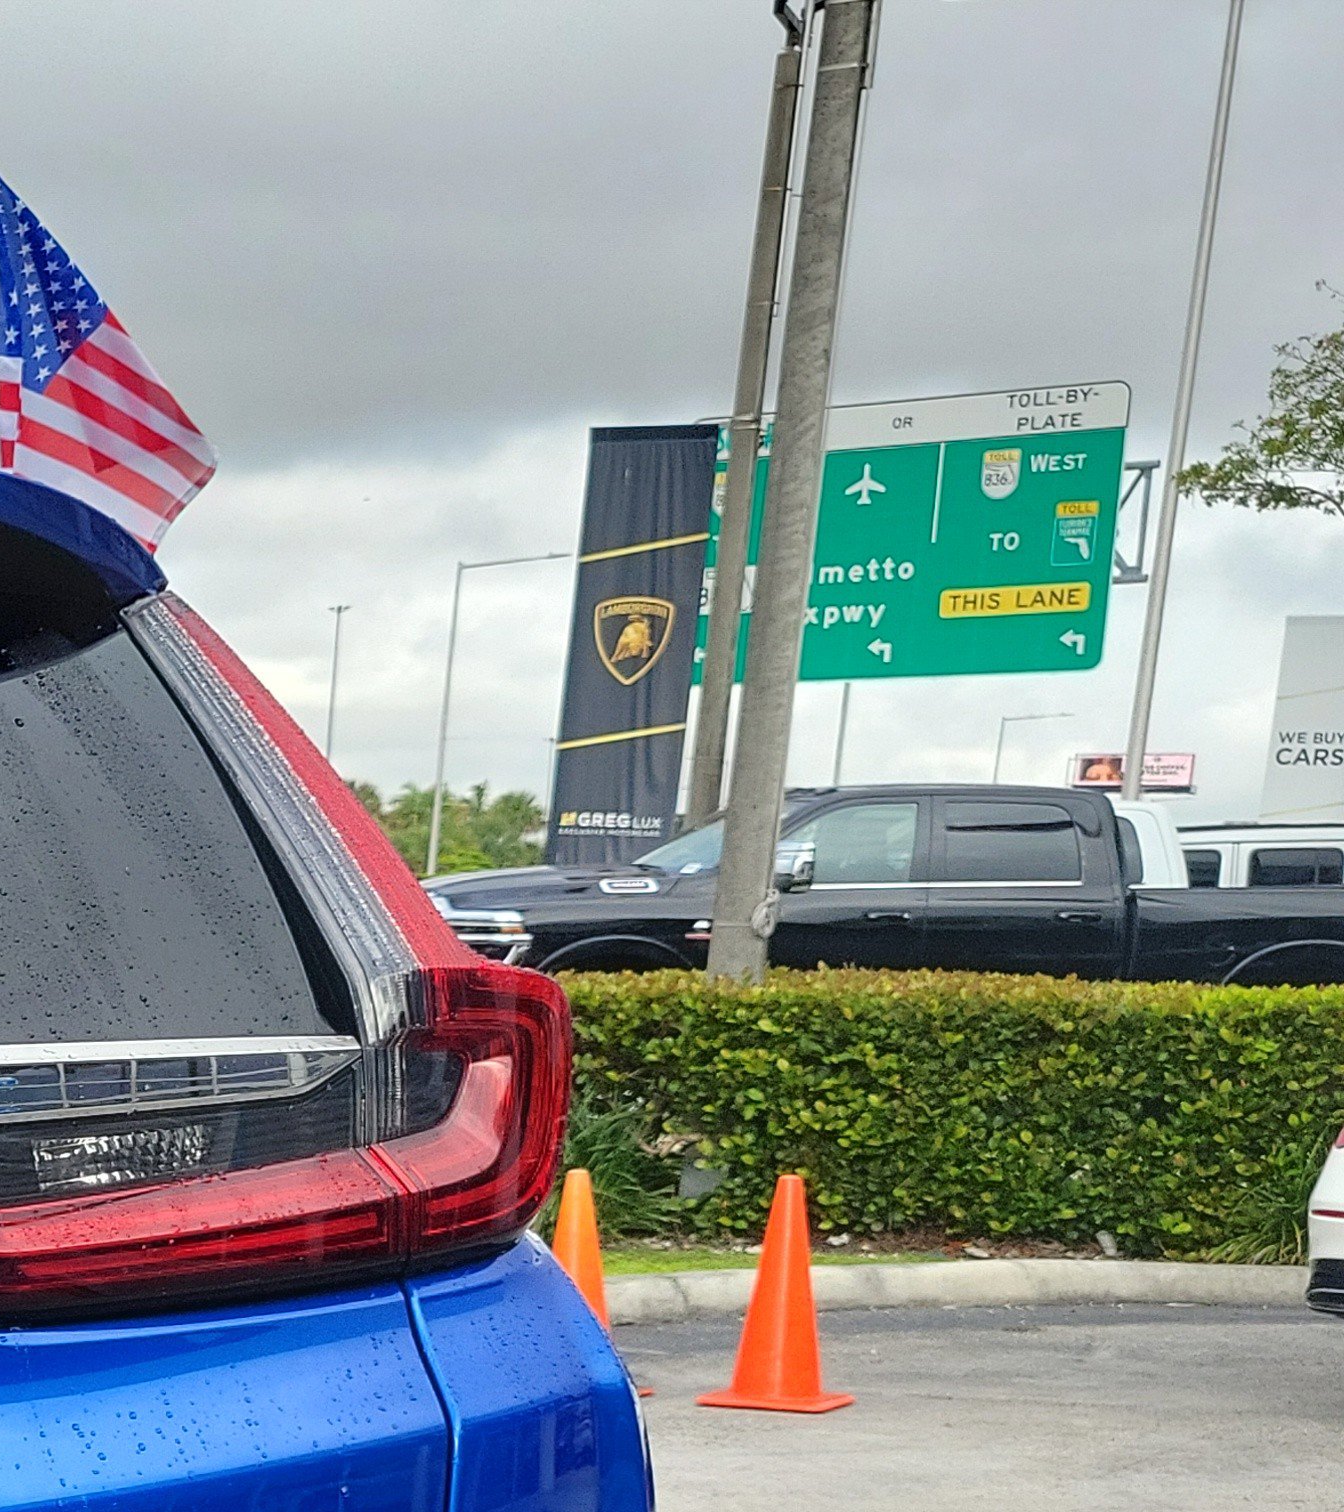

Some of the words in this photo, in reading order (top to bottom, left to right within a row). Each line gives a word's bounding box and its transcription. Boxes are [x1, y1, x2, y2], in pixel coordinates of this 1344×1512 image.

[1006, 386, 1100, 409] TOLL-BY-
[892, 416, 914, 430] OR
[1016, 411, 1083, 432] PLATE
[988, 453, 1016, 463] TOLL
[1029, 452, 1088, 473] WEST
[1061, 502, 1092, 515] TOLL
[988, 531, 1021, 552] TO
[812, 555, 916, 585] metto
[948, 592, 1001, 612] THIS
[1015, 588, 1082, 609] LANE
[1278, 731, 1308, 744] WE
[1313, 731, 1344, 744] BUY
[1275, 747, 1344, 766] CARS
